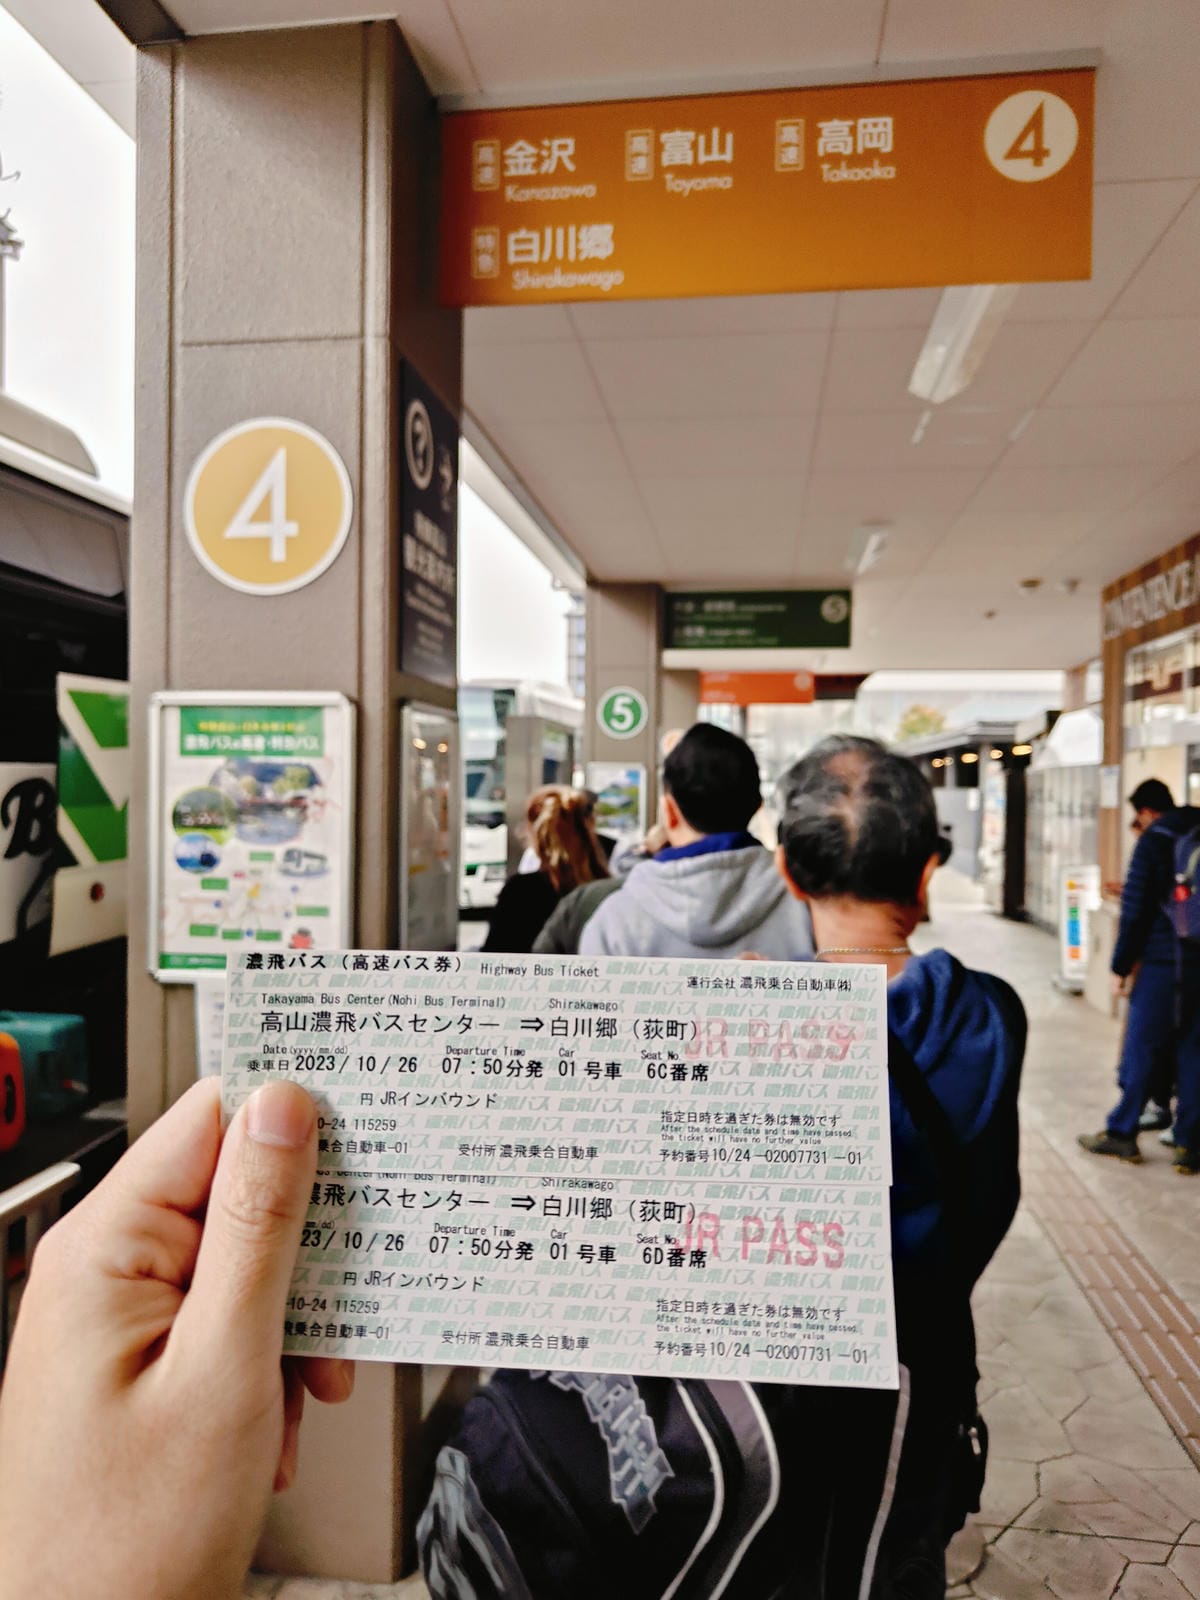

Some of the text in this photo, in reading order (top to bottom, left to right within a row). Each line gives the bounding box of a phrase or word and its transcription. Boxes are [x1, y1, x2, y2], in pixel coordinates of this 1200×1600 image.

[816, 116, 894, 157] 高岡
[1003, 100, 1052, 168] 4
[660, 127, 734, 168] 富山
[503, 137, 577, 177] 金沢
[820, 160, 897, 183] Takaoka
[664, 173, 733, 197] Toyama
[507, 224, 614, 265] 白川郷
[223, 446, 299, 562] 4
[610, 695, 635, 724] 5
[480, 962, 599, 977] Highway Bus Ticket
[687, 975, 736, 989] 運行会社
[262, 993, 315, 1006] Takayama
[321, 994, 341, 1005] Bus
[424, 995, 444, 1006] Bus
[450, 995, 506, 1009] Terminal)
[548, 999, 618, 1012] Shirakawago
[260, 1011, 500, 1034] 高山濃飛バスセンター
[445, 1045, 526, 1058] Departure Time
[558, 1048, 575, 1058] Car
[641, 1049, 663, 1060] Seat
[247, 1059, 289, 1073] 乗車日
[647, 1062, 709, 1082] 6C番席
[360, 1091, 497, 1109] 円 JRインバウンド
[354, 1118, 397, 1131] 115259
[660, 1110, 841, 1127] 指定日時を過ぎた券は無効です
[660, 1125, 682, 1133] After
[704, 1126, 739, 1134] schedule
[742, 1127, 760, 1135] date
[803, 1129, 821, 1137] have
[679, 1134, 704, 1142] ticket
[764, 1136, 794, 1144] further
[458, 1142, 599, 1160] 受付所 濃飛乗合自動車
[541, 1177, 614, 1193] Shirakawago
[434, 1222, 516, 1237] Departure Time
[550, 1229, 568, 1240] Car
[636, 1233, 659, 1245] Seat
[675, 1211, 845, 1270] JR PASS
[642, 1247, 709, 1269] 6D番席
[343, 1270, 485, 1293] 円 JRインバウンド
[335, 1299, 380, 1314] 115259
[656, 1298, 847, 1321] 指定日時を過ぎた券は無効です
[655, 1314, 680, 1323] After
[684, 1316, 698, 1324] the
[701, 1317, 739, 1326] schedule
[742, 1319, 761, 1327] date
[765, 1320, 780, 1328] and
[806, 1322, 825, 1331] have
[440, 1329, 591, 1351] 受付所 濃飛乗合自動車
[656, 1324, 671, 1332] the
[675, 1325, 702, 1334] ticket
[706, 1327, 724, 1335] will
[729, 1327, 748, 1336] have
[766, 1329, 797, 1339] further
[802, 1331, 825, 1340] value
